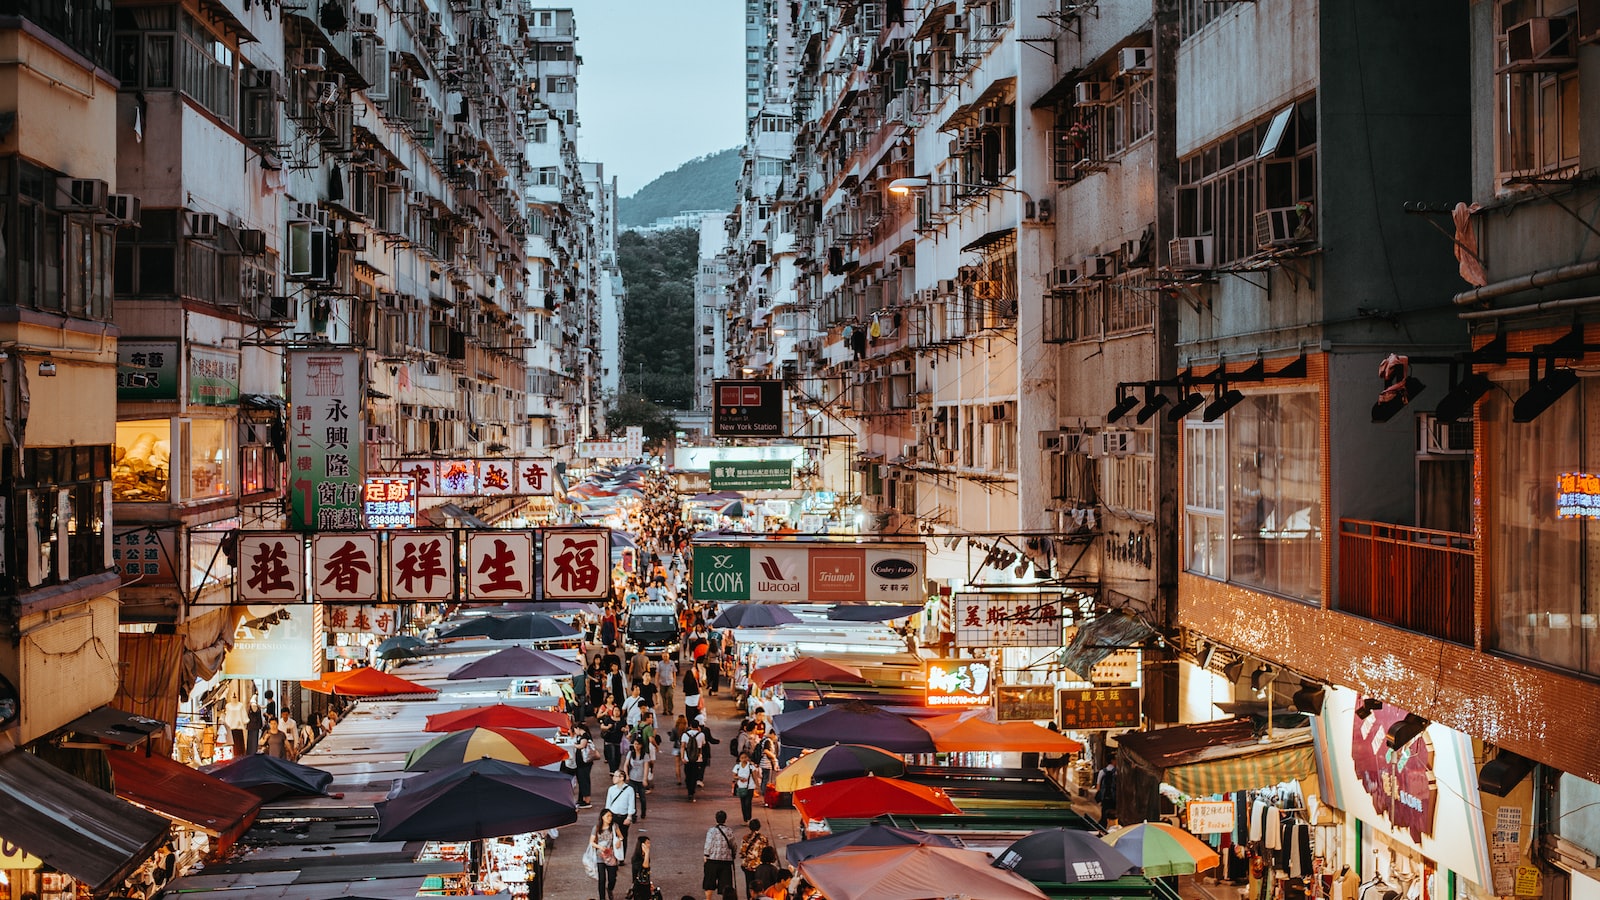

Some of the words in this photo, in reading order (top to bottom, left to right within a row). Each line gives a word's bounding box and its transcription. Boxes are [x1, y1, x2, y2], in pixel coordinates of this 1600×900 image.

[297, 406, 311, 471] 請上一樓
[325, 399, 348, 477] 永興隆
[366, 484, 408, 501] 足跡
[700, 572, 744, 593] LEONA
[757, 581, 800, 592] Wacoal
[819, 571, 855, 583] Triumph
